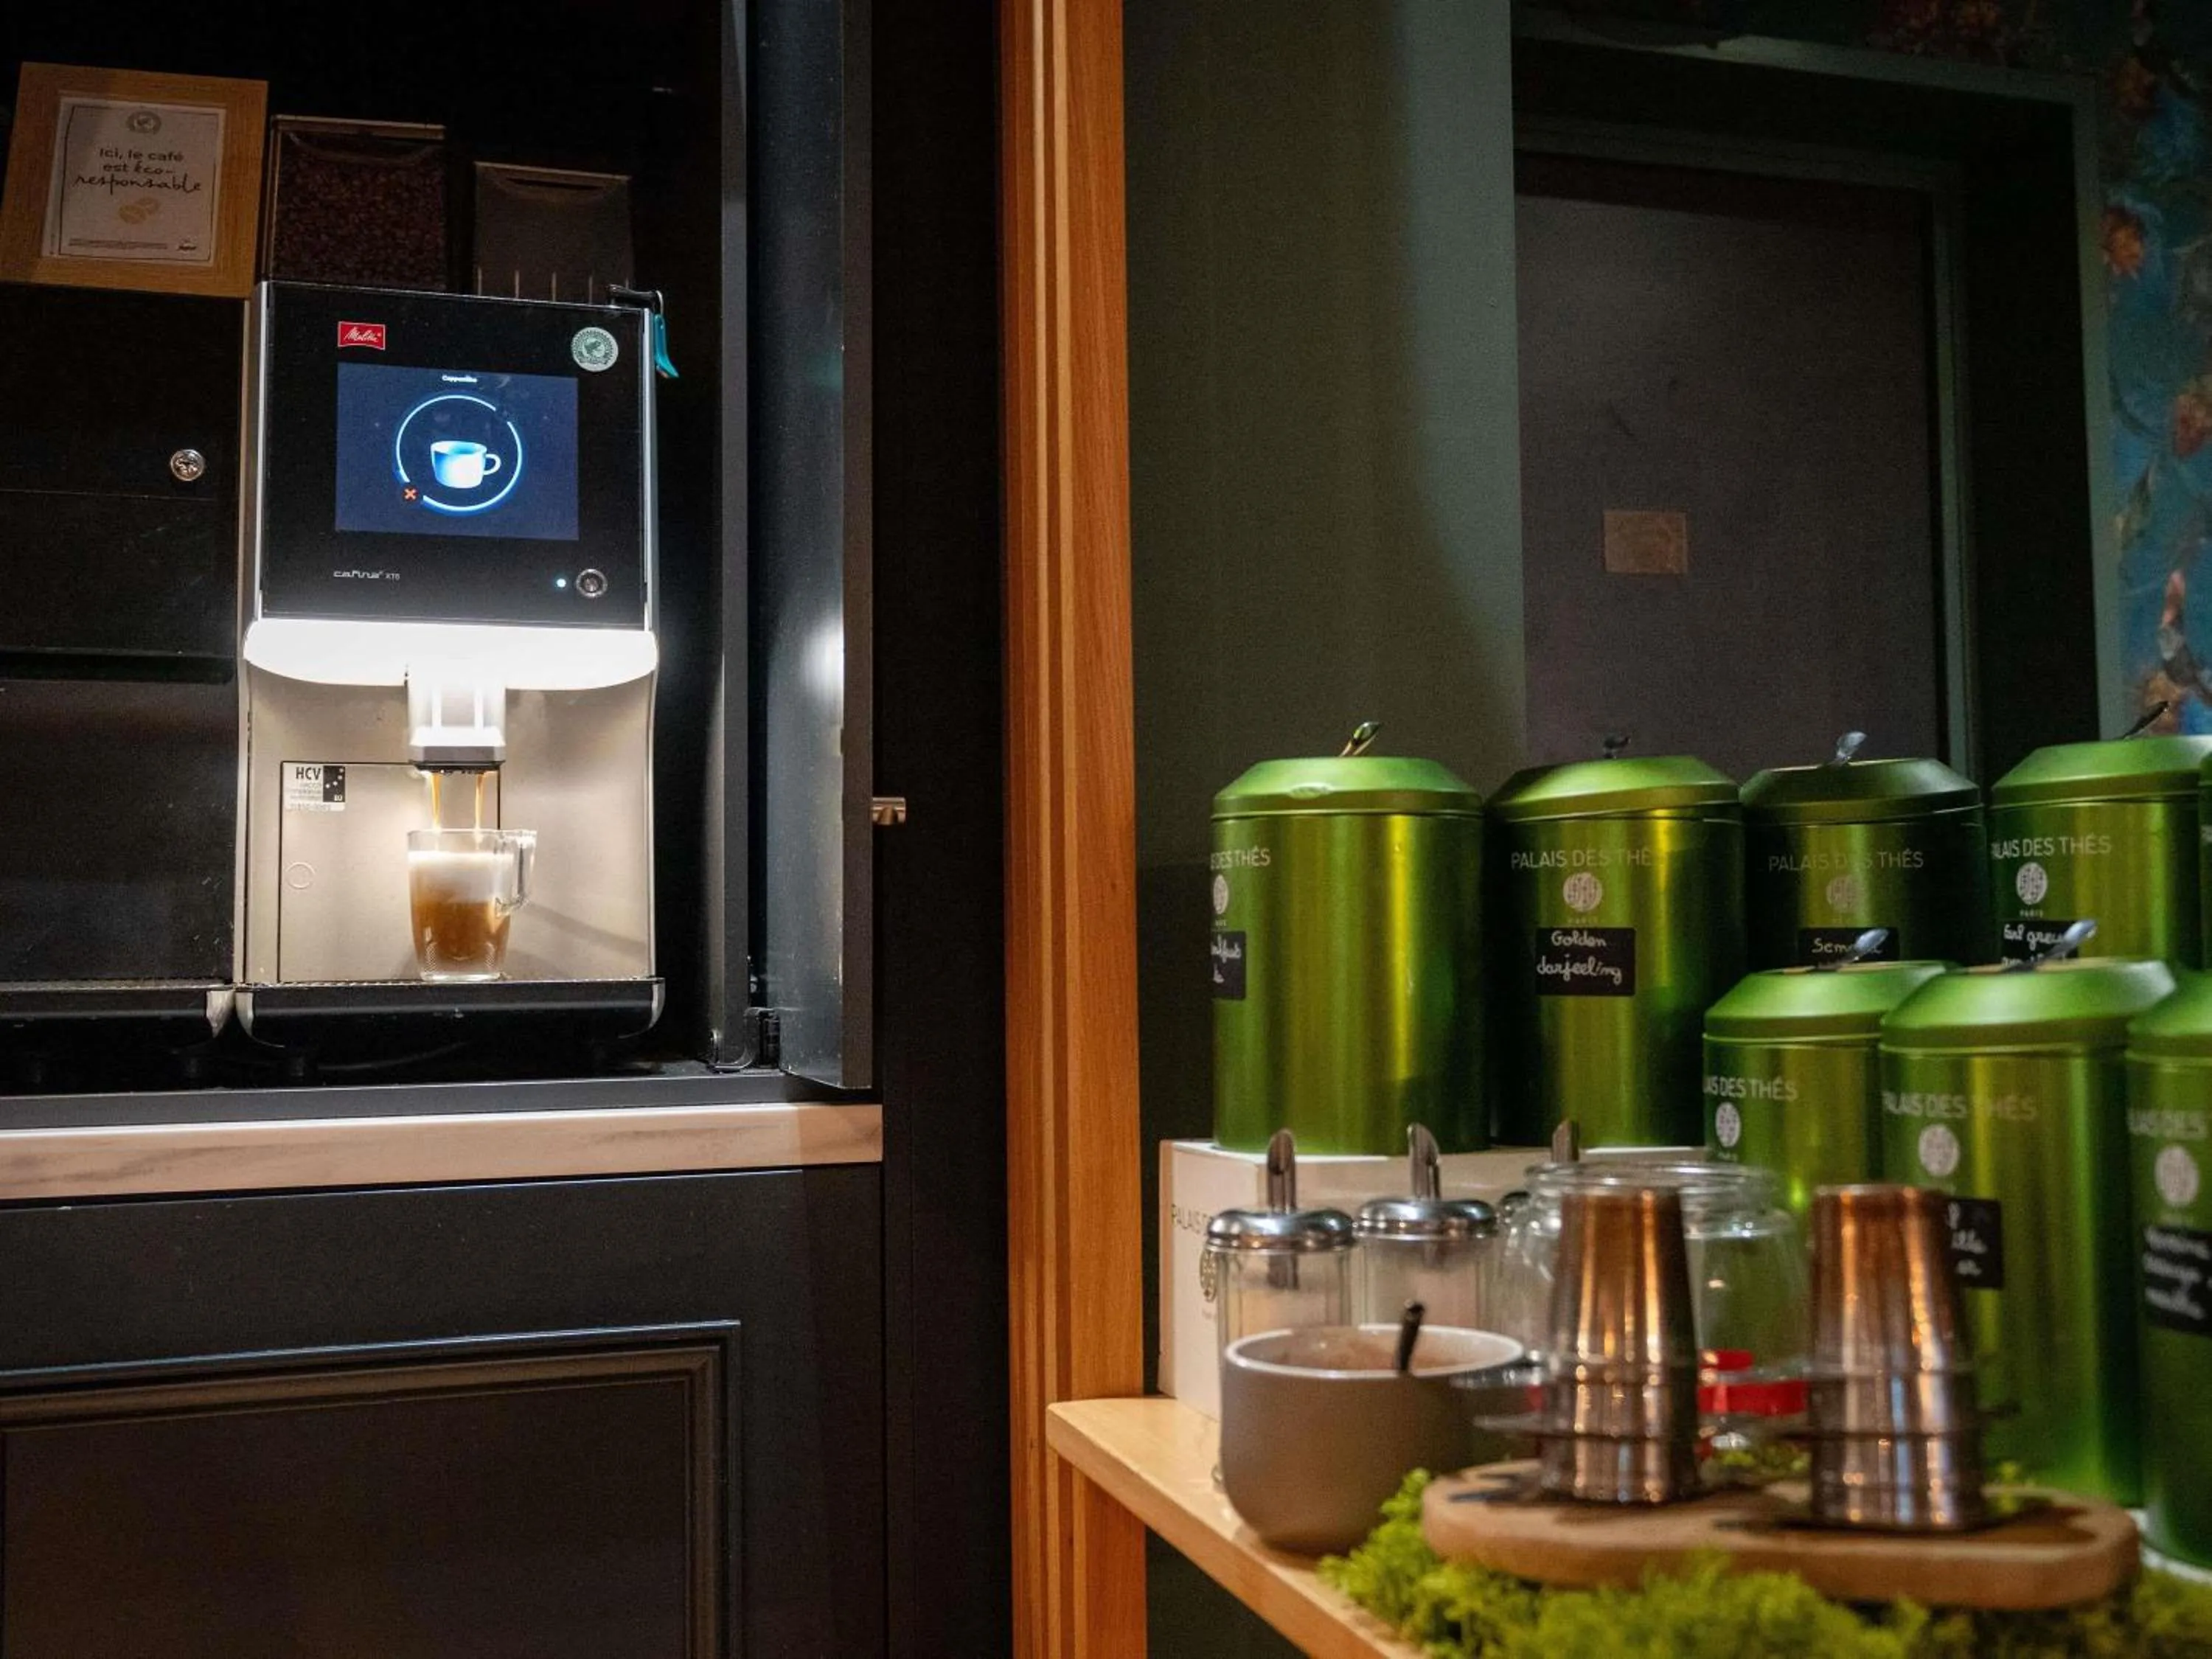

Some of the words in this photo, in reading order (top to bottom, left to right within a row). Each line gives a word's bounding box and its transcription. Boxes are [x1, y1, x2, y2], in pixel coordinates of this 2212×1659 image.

[99, 148, 122, 160] Ici,
[128, 150, 143, 160] le
[147, 151, 184, 161] café
[103, 163, 129, 173] est
[74, 173, 201, 195] responsable
[296, 766, 321, 780] HCV
[2023, 838, 2055, 857] DES
[2057, 834, 2112, 855] THÉS
[1234, 846, 1271, 868] THÉS
[1511, 850, 1568, 869] PALAIS
[1572, 849, 1608, 867] DES
[1610, 846, 1658, 866] THÉ
[1769, 852, 1829, 872] PALAIS
[1834, 852, 1875, 869] DS
[1877, 848, 1924, 869] THÉS
[1551, 931, 1607, 947] Golden
[1537, 954, 1621, 985] darjeeling
